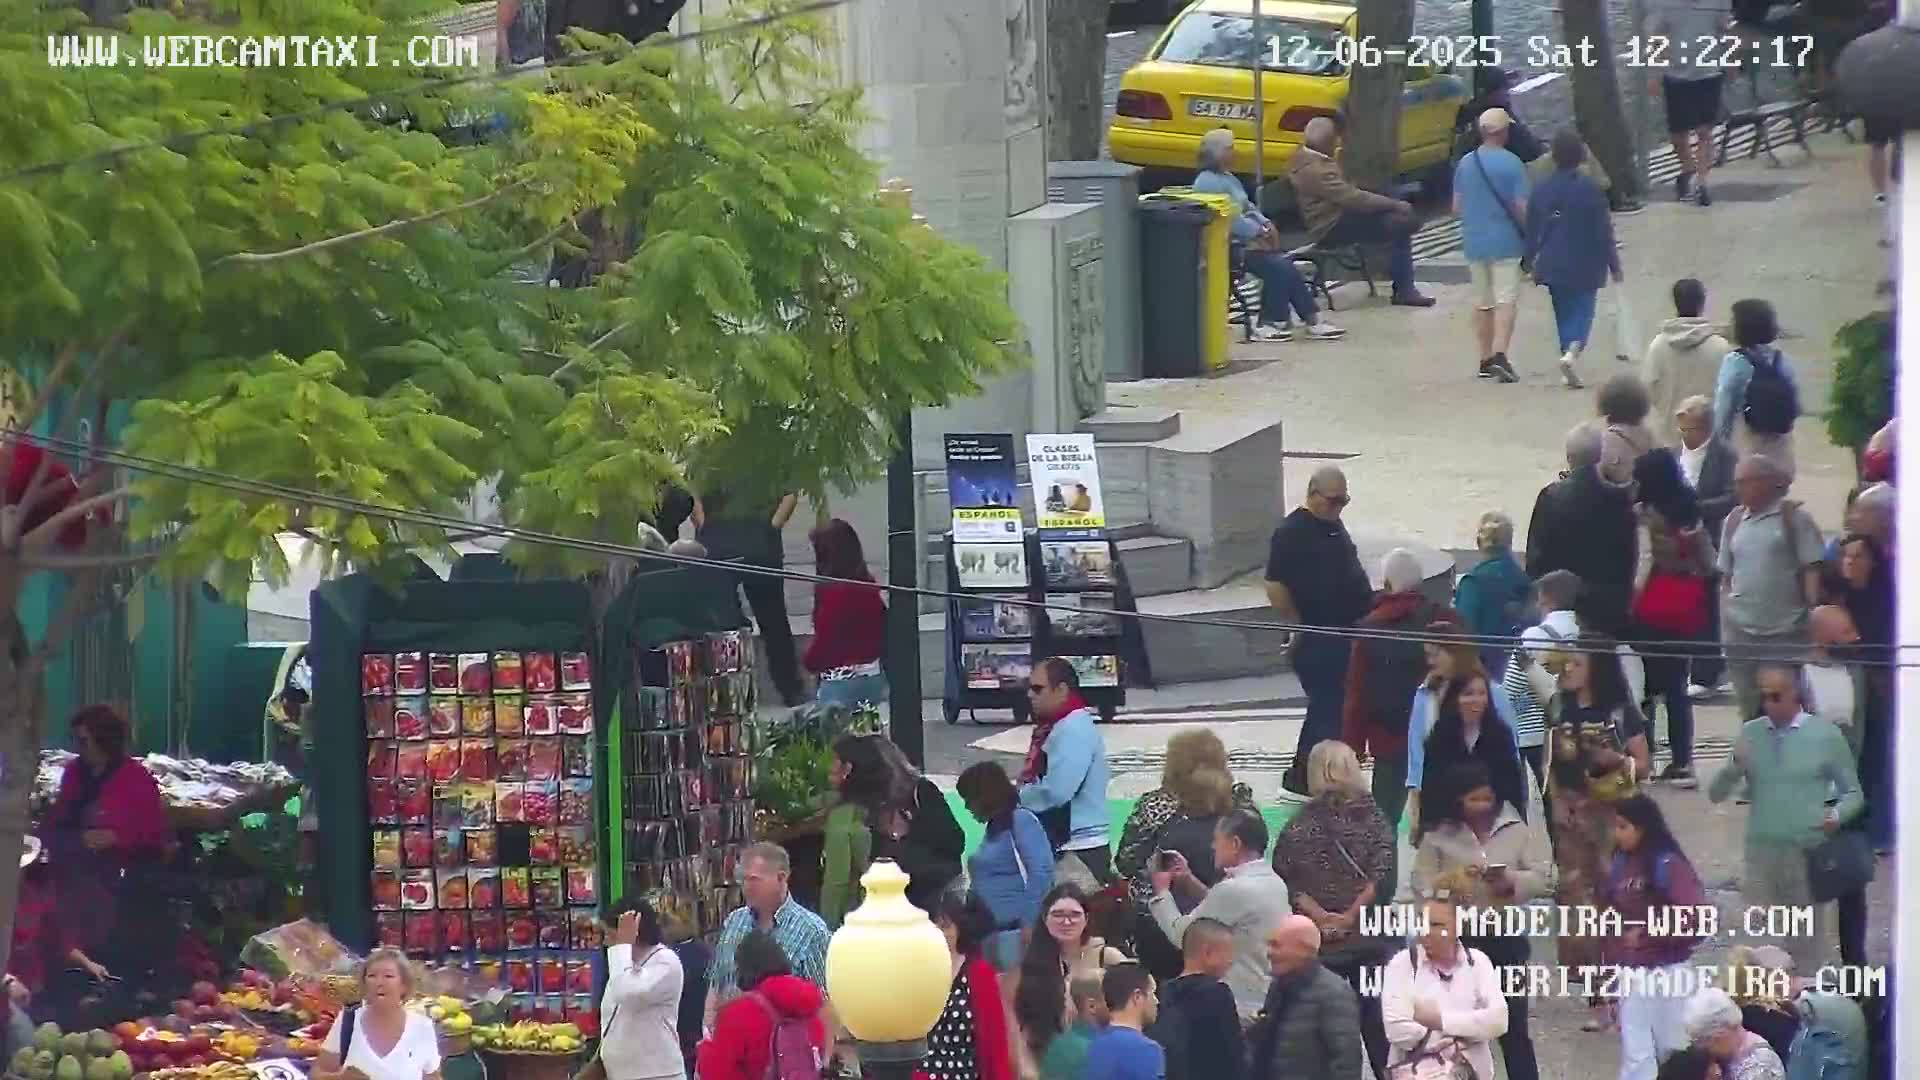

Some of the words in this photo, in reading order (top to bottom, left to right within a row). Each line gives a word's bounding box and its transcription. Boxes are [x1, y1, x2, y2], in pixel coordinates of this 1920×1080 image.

[1042, 445, 1080, 453] CLASES
[1031, 454, 1044, 462] DE
[1046, 454, 1059, 462] LA
[1061, 454, 1094, 462] BIBLIA
